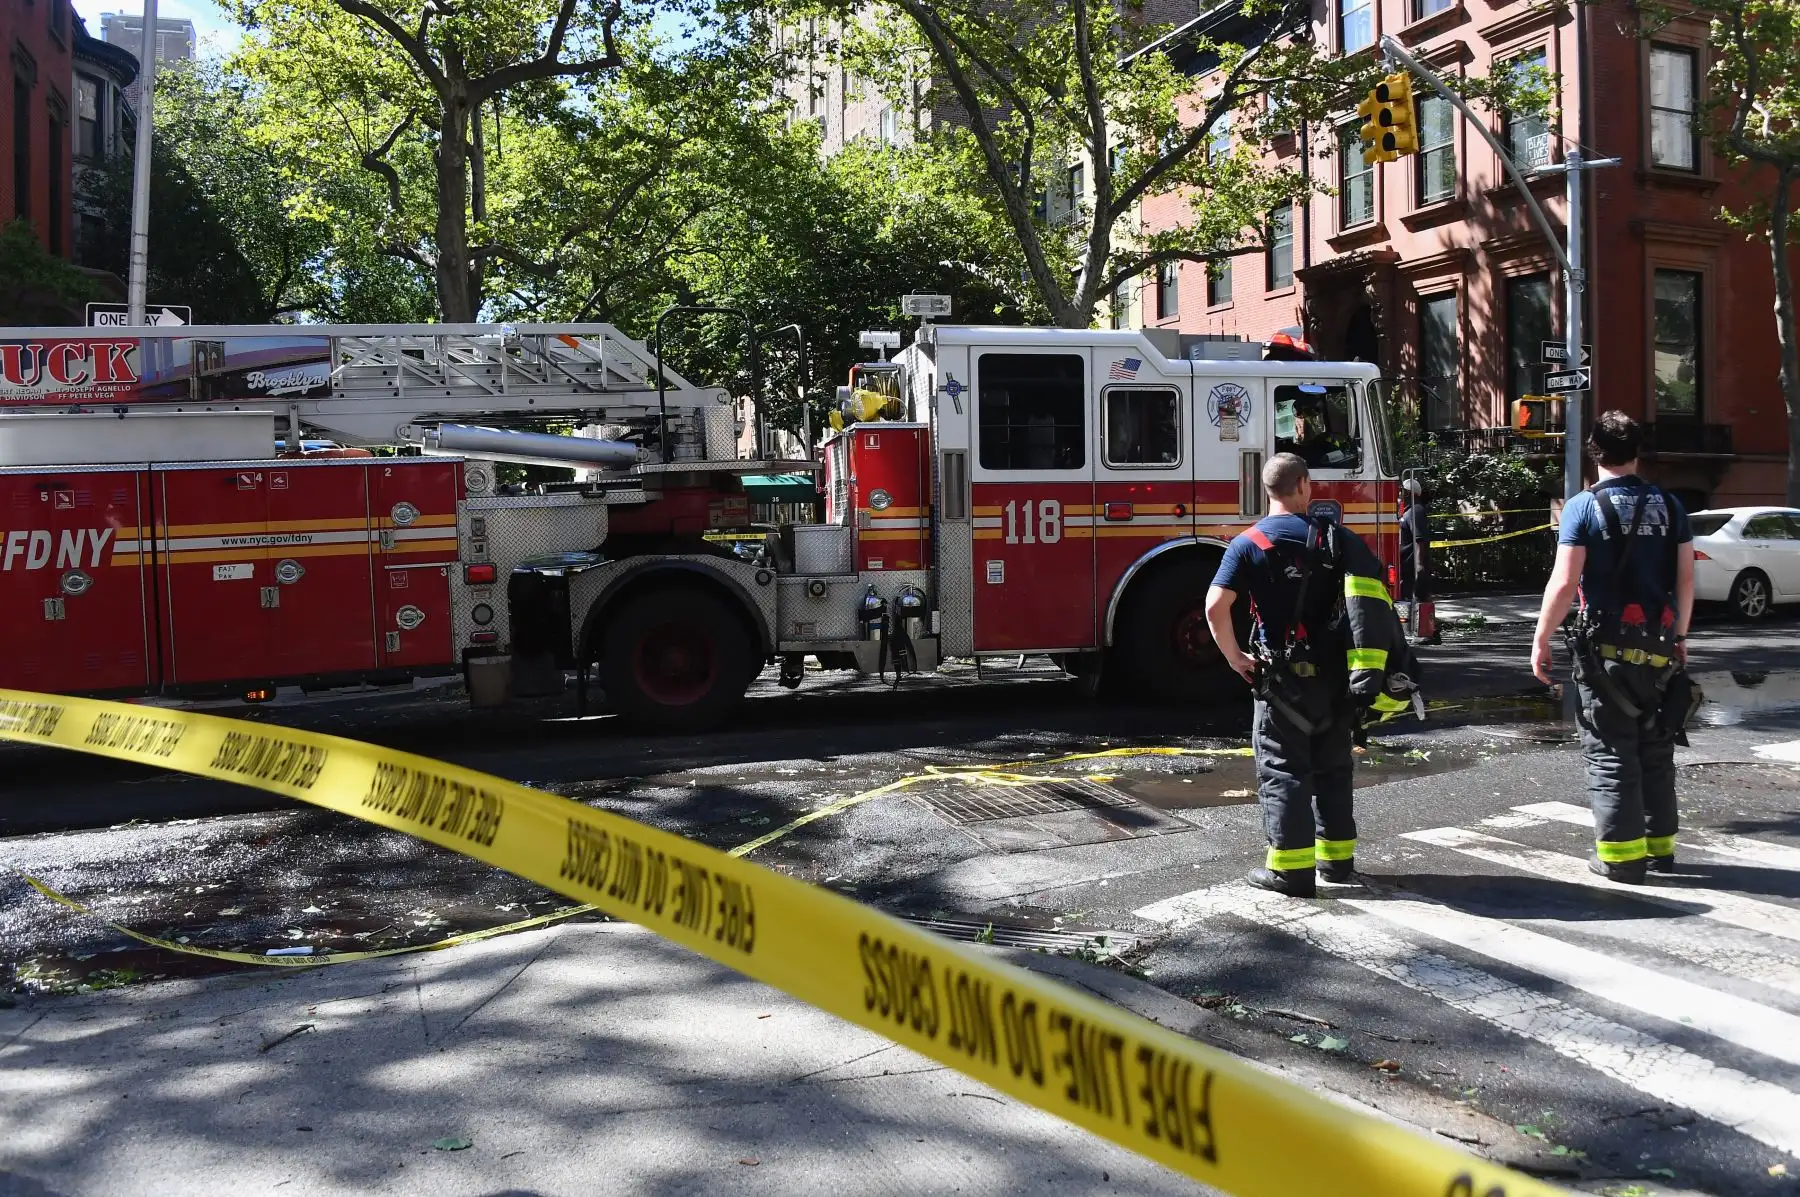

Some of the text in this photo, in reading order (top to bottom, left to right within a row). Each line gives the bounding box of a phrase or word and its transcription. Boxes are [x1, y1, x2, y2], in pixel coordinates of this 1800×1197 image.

[100, 313, 160, 326] ONE AY
[1550, 348, 1564, 358] ONE
[246, 371, 325, 395] Brooklyn
[1551, 375, 1582, 387] ONE WAY
[256, 472, 263, 482] 4
[385, 467, 392, 477] 2
[40, 491, 48, 502] 5
[221, 533, 313, 546] www.nyc.gov/fdny
[1006, 499, 1061, 544] 118
[3, 528, 113, 571] FDNY
[440, 568, 447, 577] 3
[84, 712, 121, 746] CROSS
[155, 722, 187, 757] FIRE
[210, 731, 252, 771] CROSS
[237, 735, 271, 776] NOT
[256, 738, 283, 779] DO
[293, 745, 328, 789] FIRE
[361, 761, 408, 813] CROSS
[395, 769, 431, 821] NOT
[420, 774, 447, 827] DO
[467, 787, 504, 847] FIRE
[560, 817, 613, 892] CROSS
[608, 834, 644, 905] NOT
[643, 846, 669, 917] DO
[713, 872, 756, 954] FIRE
[859, 930, 940, 1041] CROSS
[945, 965, 998, 1067] NOT
[1001, 989, 1046, 1089] DO
[1136, 1042, 1218, 1164] FIRE
